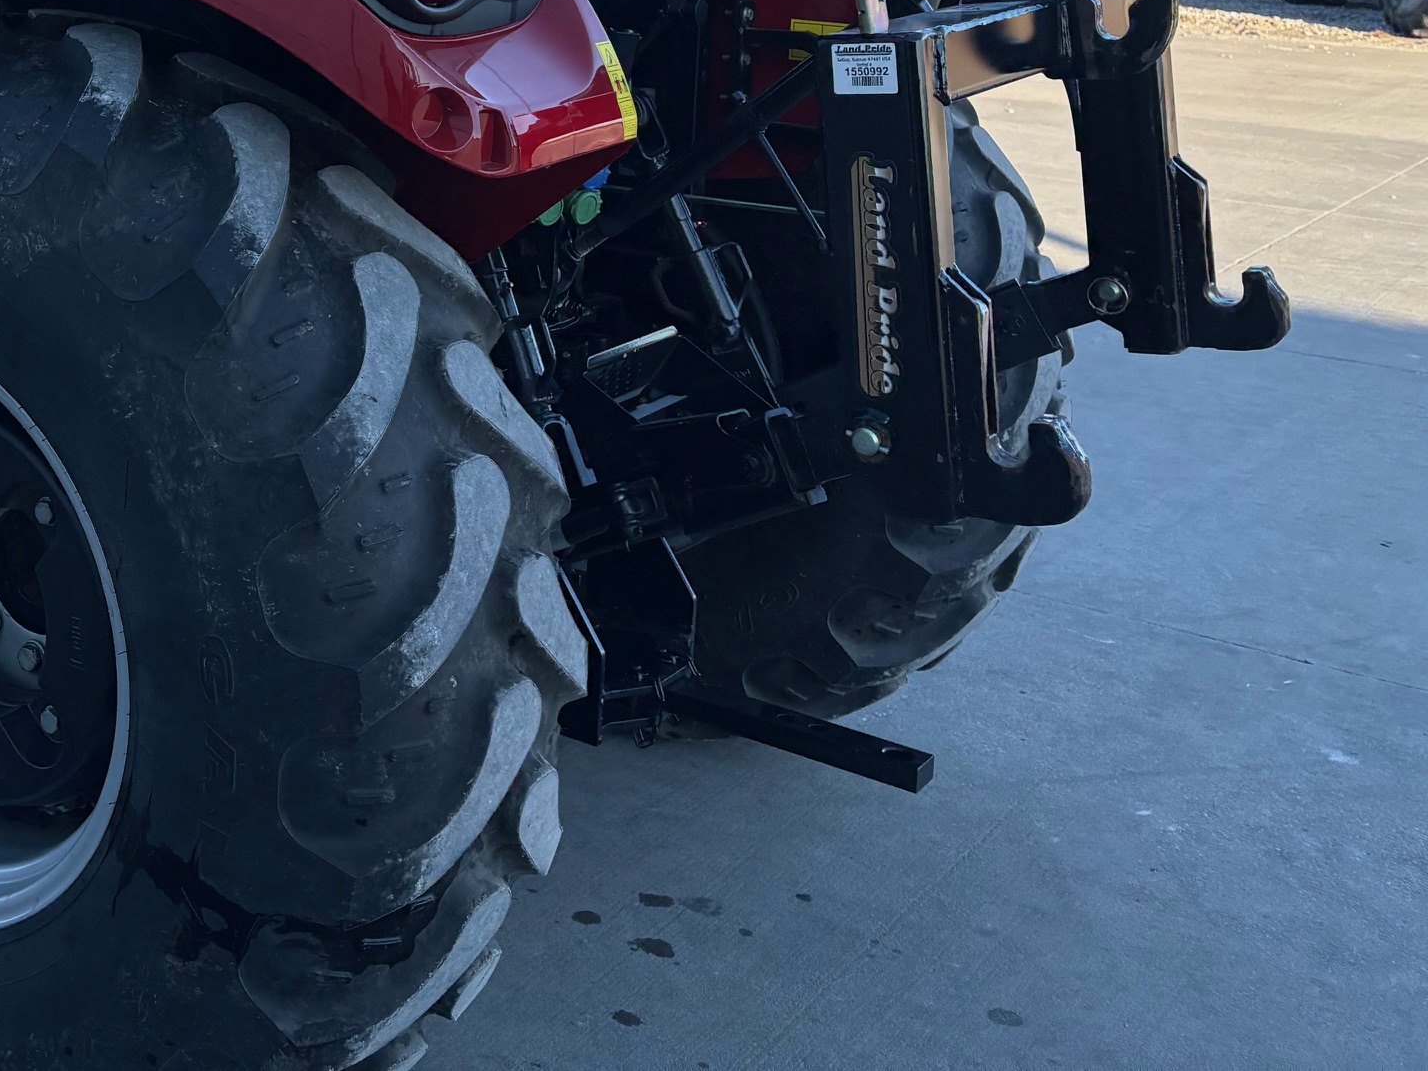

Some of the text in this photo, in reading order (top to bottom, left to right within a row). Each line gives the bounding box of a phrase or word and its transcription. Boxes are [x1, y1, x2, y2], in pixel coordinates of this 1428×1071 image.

[834, 44, 893, 54] Land Pride
[845, 67, 889, 76] 1550992
[862, 159, 900, 395] Land Pride
